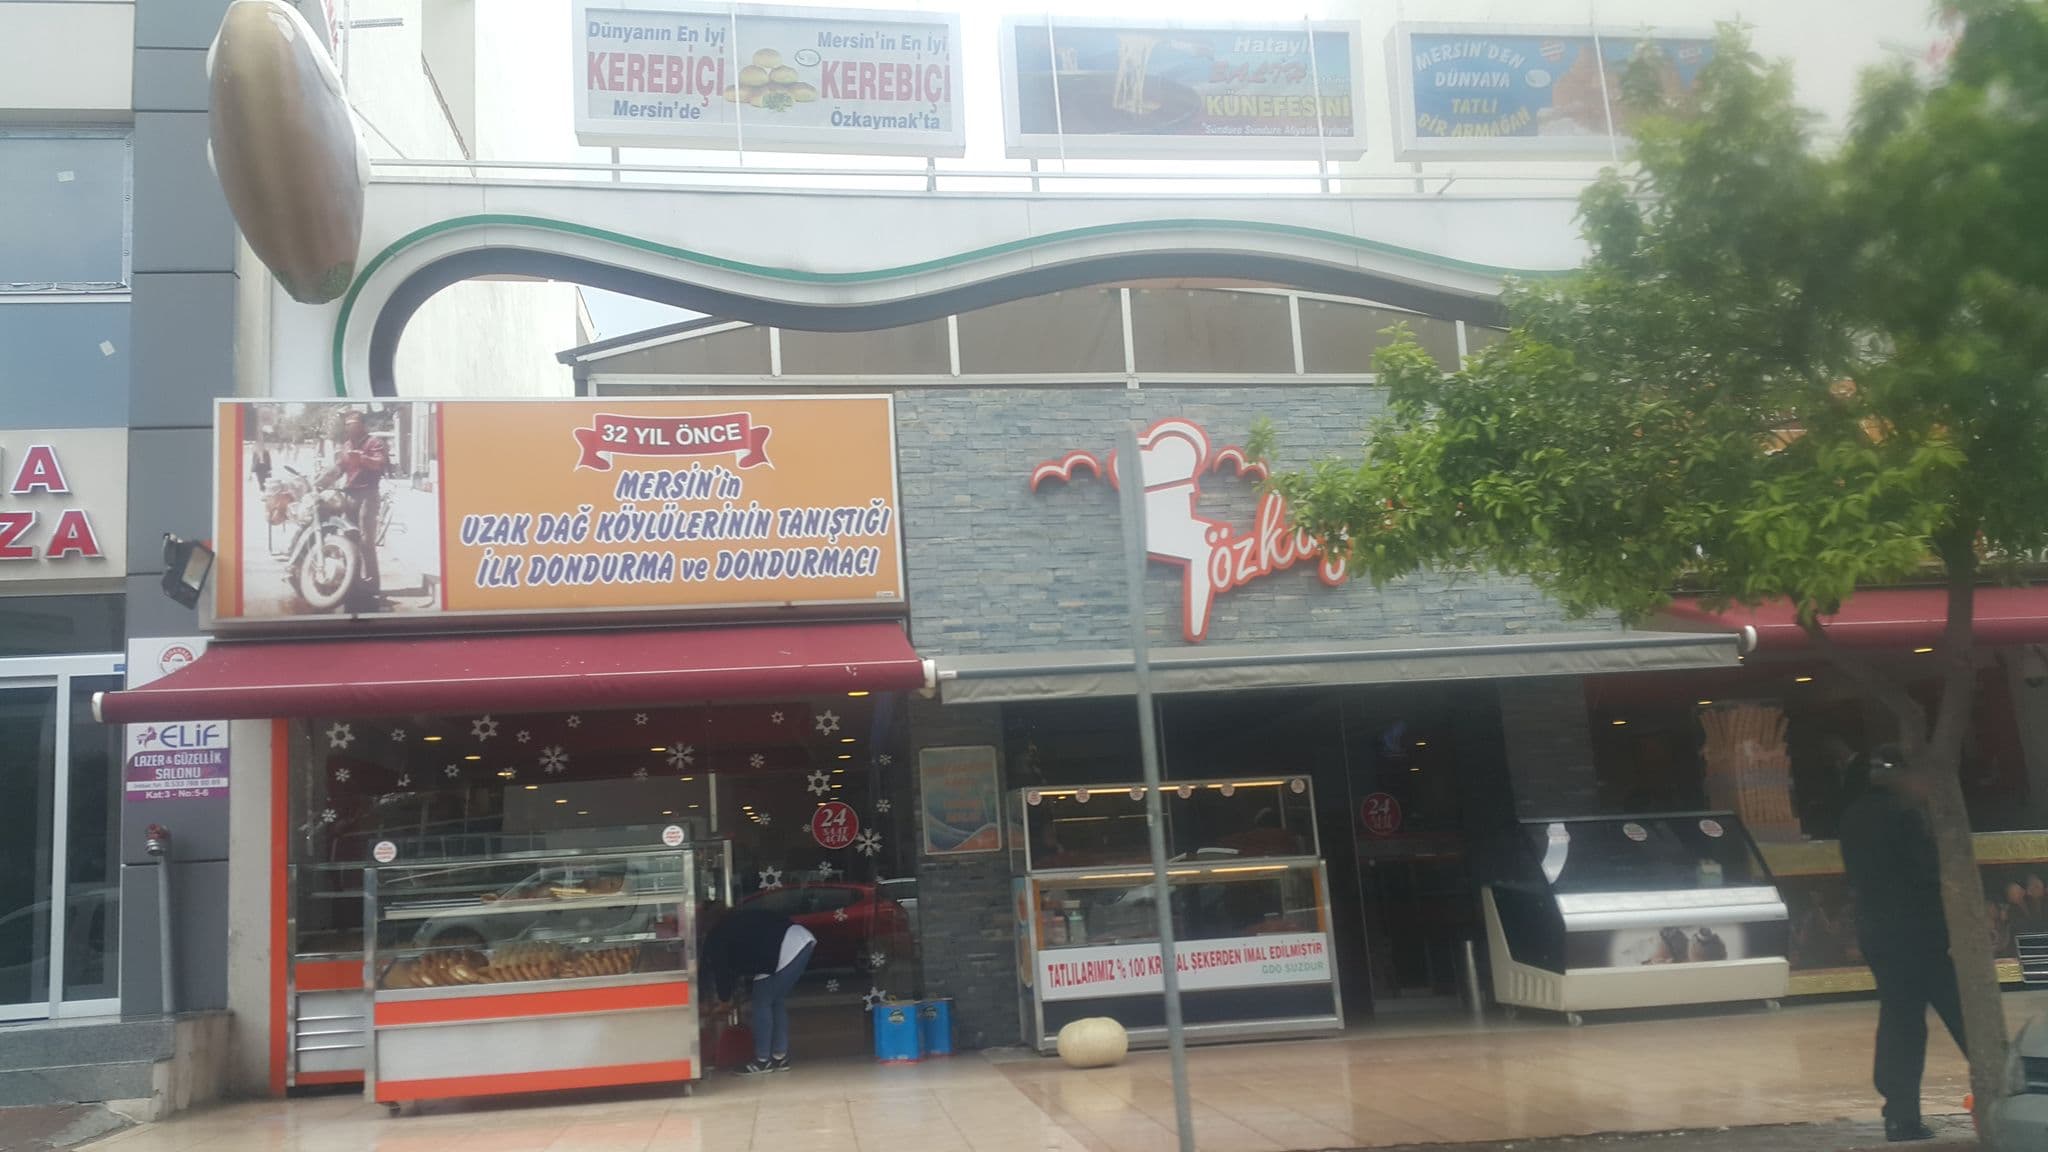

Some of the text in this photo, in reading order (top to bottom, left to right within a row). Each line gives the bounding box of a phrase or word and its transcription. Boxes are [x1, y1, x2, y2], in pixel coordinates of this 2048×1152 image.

[588, 22, 725, 46] Dünyanın En İyi
[818, 32, 947, 54] Mersin'in En İyi
[587, 45, 725, 107] KEREBİÇİ
[821, 53, 951, 113] KEREBİÇİ
[1435, 68, 1510, 88] DÜNYAYA
[613, 100, 701, 119] Mersin'de
[831, 107, 940, 130] Özkaymak'ta
[602, 423, 742, 446] 32 YIL ÖNCE
[10, 445, 70, 494] A
[616, 462, 741, 500] MERSİN'in
[462, 498, 892, 544] UZAK DAĞ KÖYLÜLERİNİN TANIŞTIĞI
[476, 547, 879, 588] İLK DONDURMA ve DONDURMACI
[134, 751, 222, 767] LAZER & GÜZELLİK
[155, 767, 200, 780] SALONU
[821, 808, 847, 827] 24
[1368, 798, 1390, 815] 24
[1048, 957, 1115, 988] TATLILARIMIZ
[1117, 959, 1127, 979] %
[1128, 957, 1145, 978] 100
[1147, 953, 1189, 976] KRAL
[1190, 949, 1242, 974] ŞEKERDEN
[1243, 943, 1267, 963] İMAL
[1261, 963, 1282, 975] GDO
